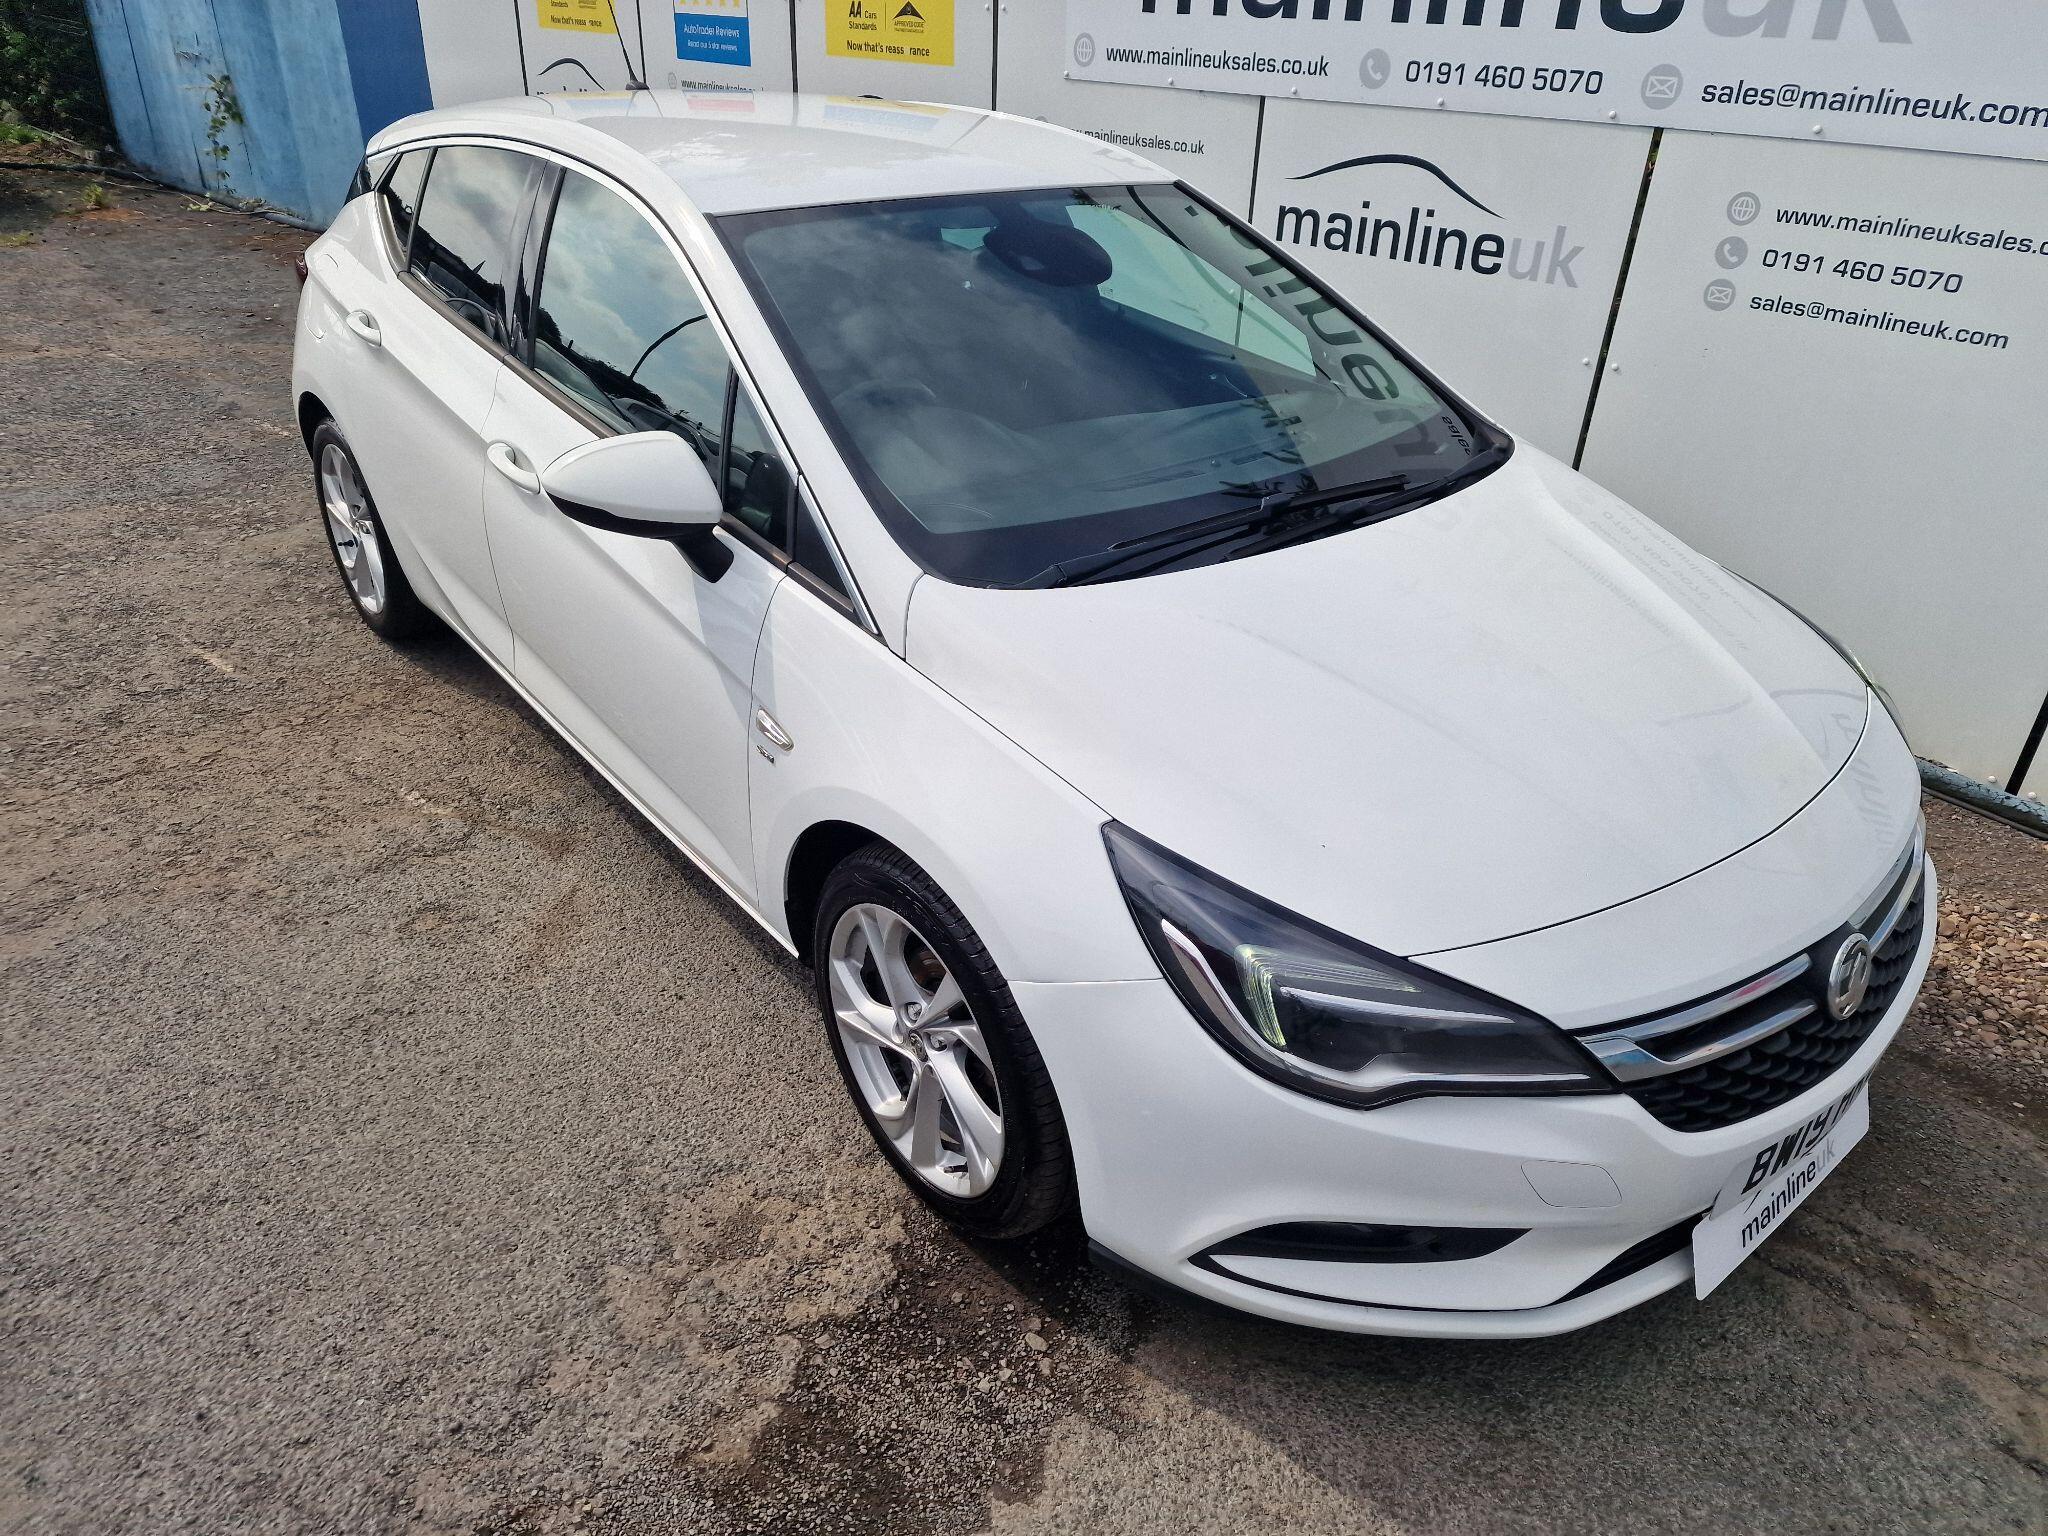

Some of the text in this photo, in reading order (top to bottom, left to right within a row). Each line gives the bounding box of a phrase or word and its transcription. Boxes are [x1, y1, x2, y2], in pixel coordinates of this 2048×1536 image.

[716, 25, 740, 38] Reviews
[848, 20, 877, 31] Standards
[864, 10, 877, 19] Cars
[720, 43, 738, 52] reviews
[846, 40, 863, 51] Now
[863, 41, 884, 53] that's
[1106, 44, 1329, 77] www.mainlineuksales.co.uk
[1404, 59, 1604, 95] 0191 460 5070
[1701, 79, 2048, 128] sales@mainlineuk.com
[1275, 201, 1585, 288] mainlineuk
[1762, 248, 1963, 294] 0191 460 5070
[1749, 295, 2010, 349] sales@mainlineuk.com
[1741, 1137, 1836, 1249] mainlineuk
